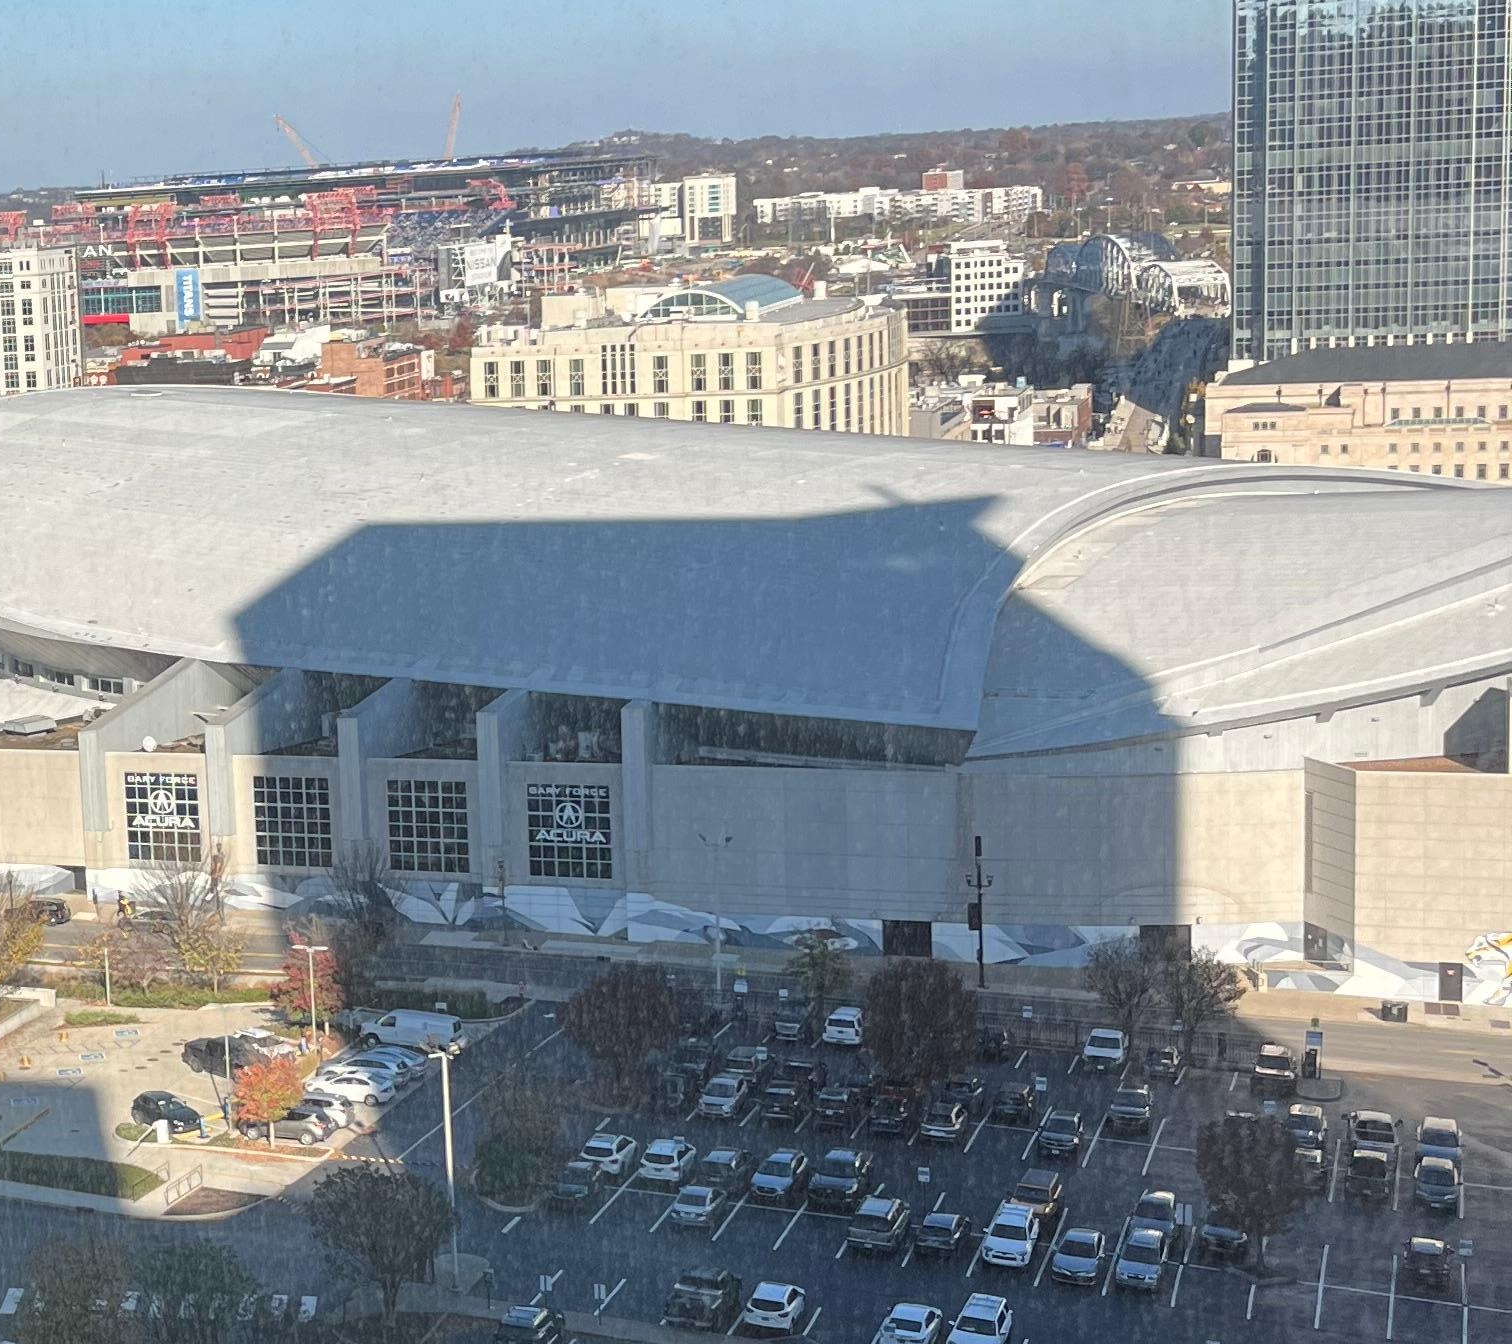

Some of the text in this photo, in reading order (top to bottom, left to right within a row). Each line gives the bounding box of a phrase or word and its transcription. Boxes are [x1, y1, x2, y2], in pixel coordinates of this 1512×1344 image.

[182, 274, 194, 317] TITANS
[529, 786, 607, 797] GARY FORCE
[132, 816, 195, 829] ACURA
[535, 829, 607, 843] ACURA
